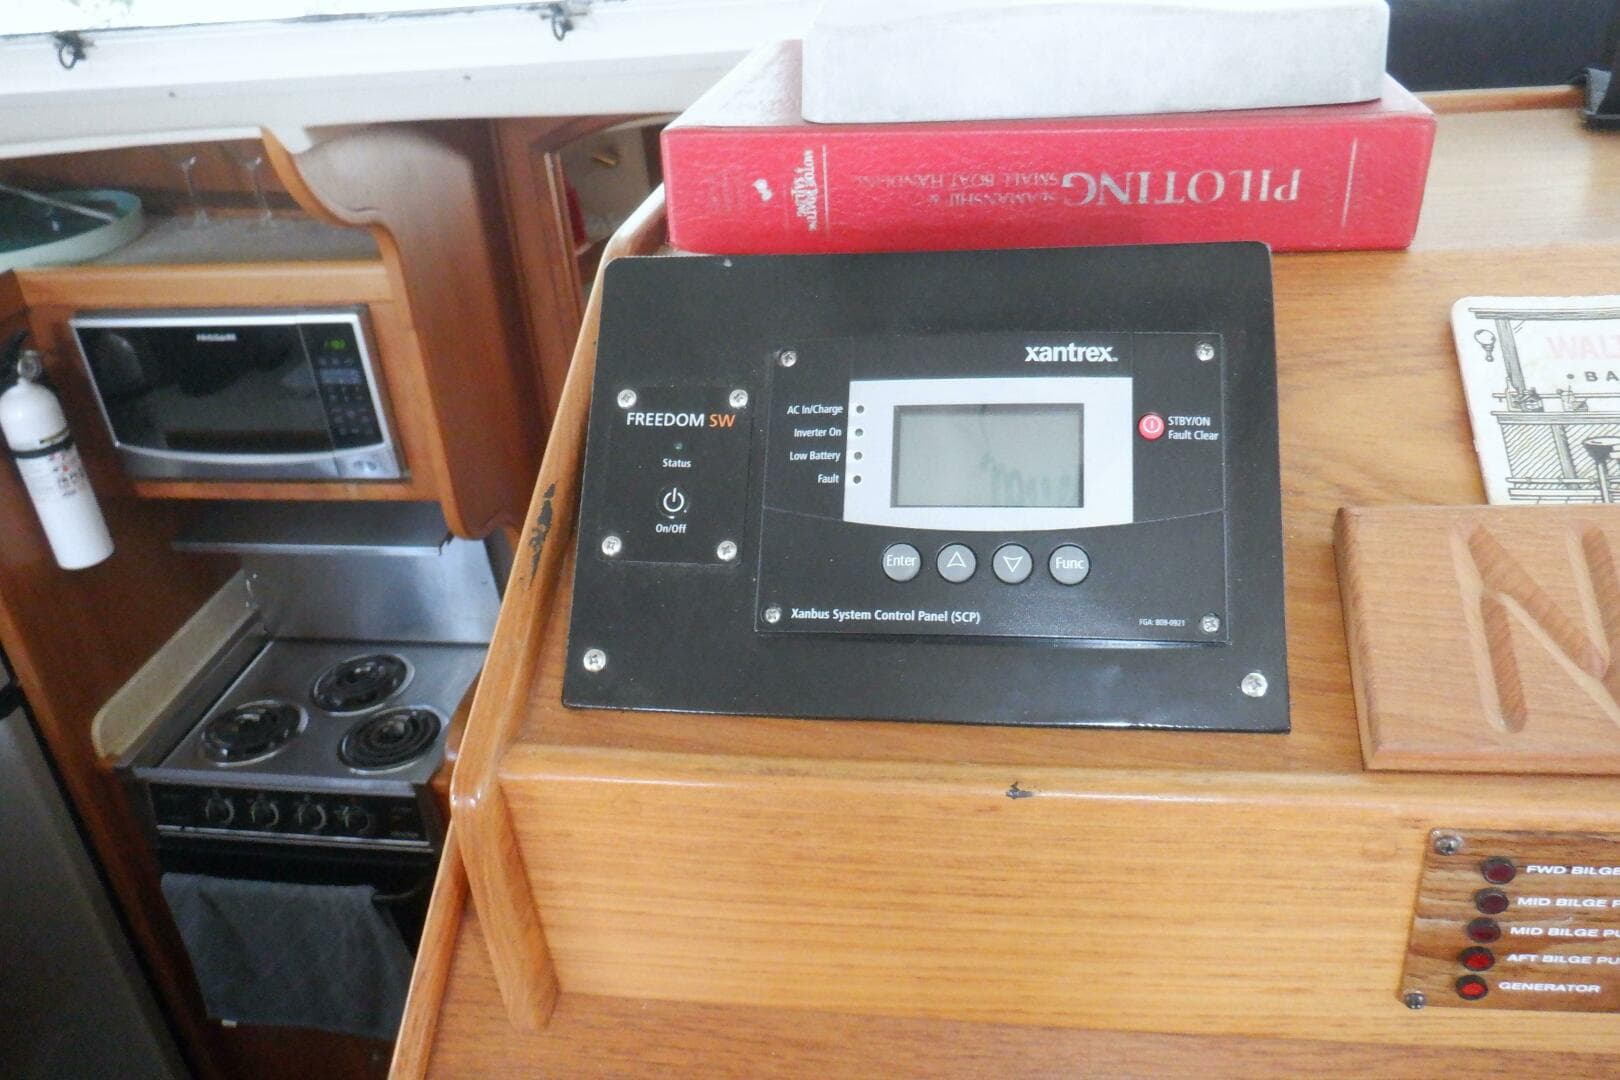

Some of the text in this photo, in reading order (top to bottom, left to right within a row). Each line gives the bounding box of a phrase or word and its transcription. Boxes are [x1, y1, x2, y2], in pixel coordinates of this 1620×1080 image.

[1061, 169, 1301, 207] PILOTING
[1024, 343, 1113, 362] xantrex
[1544, 335, 1620, 360] WAL
[787, 404, 843, 416] AC In/Charge
[626, 412, 735, 428] FREEDOM SW
[1168, 416, 1210, 426] STBY/ON
[794, 427, 842, 438] Inverter On
[1168, 430, 1219, 440] Fault Clear
[790, 450, 841, 462] Low Battery
[662, 458, 692, 469] Status
[817, 473, 839, 484] Fault
[655, 523, 687, 534] On/Off
[886, 554, 917, 568] Enter
[1055, 556, 1085, 570] Func
[791, 608, 981, 624] Xanbus System Control Panel (SCP)
[1526, 865, 1620, 876] FWD BILGE
[1517, 897, 1551, 907] MID
[1555, 898, 1608, 908] BILGE
[1510, 926, 1543, 936] MID
[1547, 927, 1598, 937] BILGE
[1507, 954, 1539, 963] AFT
[1542, 955, 1592, 965] BILGE
[1498, 981, 1601, 993] GENERATOR
